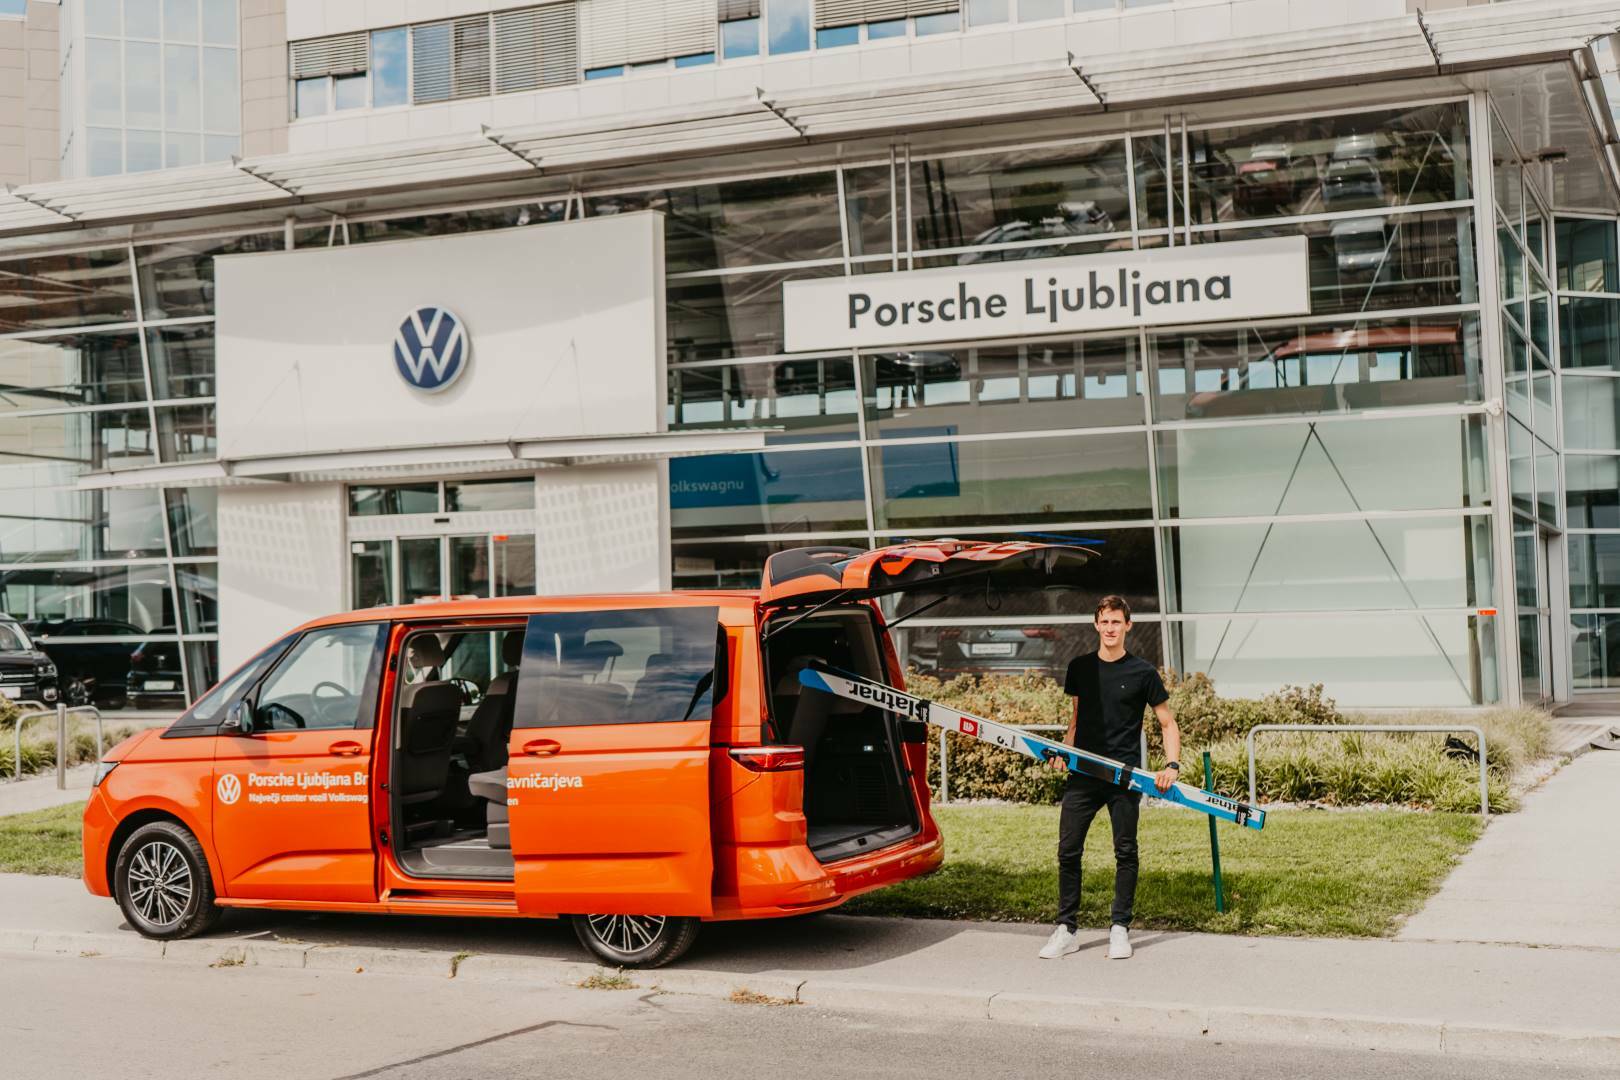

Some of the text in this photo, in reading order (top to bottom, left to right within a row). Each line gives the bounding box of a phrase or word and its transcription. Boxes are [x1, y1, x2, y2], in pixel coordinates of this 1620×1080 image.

[848, 267, 1232, 329] Porsche Ljubljana
[670, 479, 745, 495] olkswagnu
[248, 772, 294, 786] Porsche
[297, 771, 352, 789] Ljubljana
[506, 772, 584, 792] avničarjeva
[281, 794, 307, 802] center
[1205, 797, 1253, 819] Satnar
